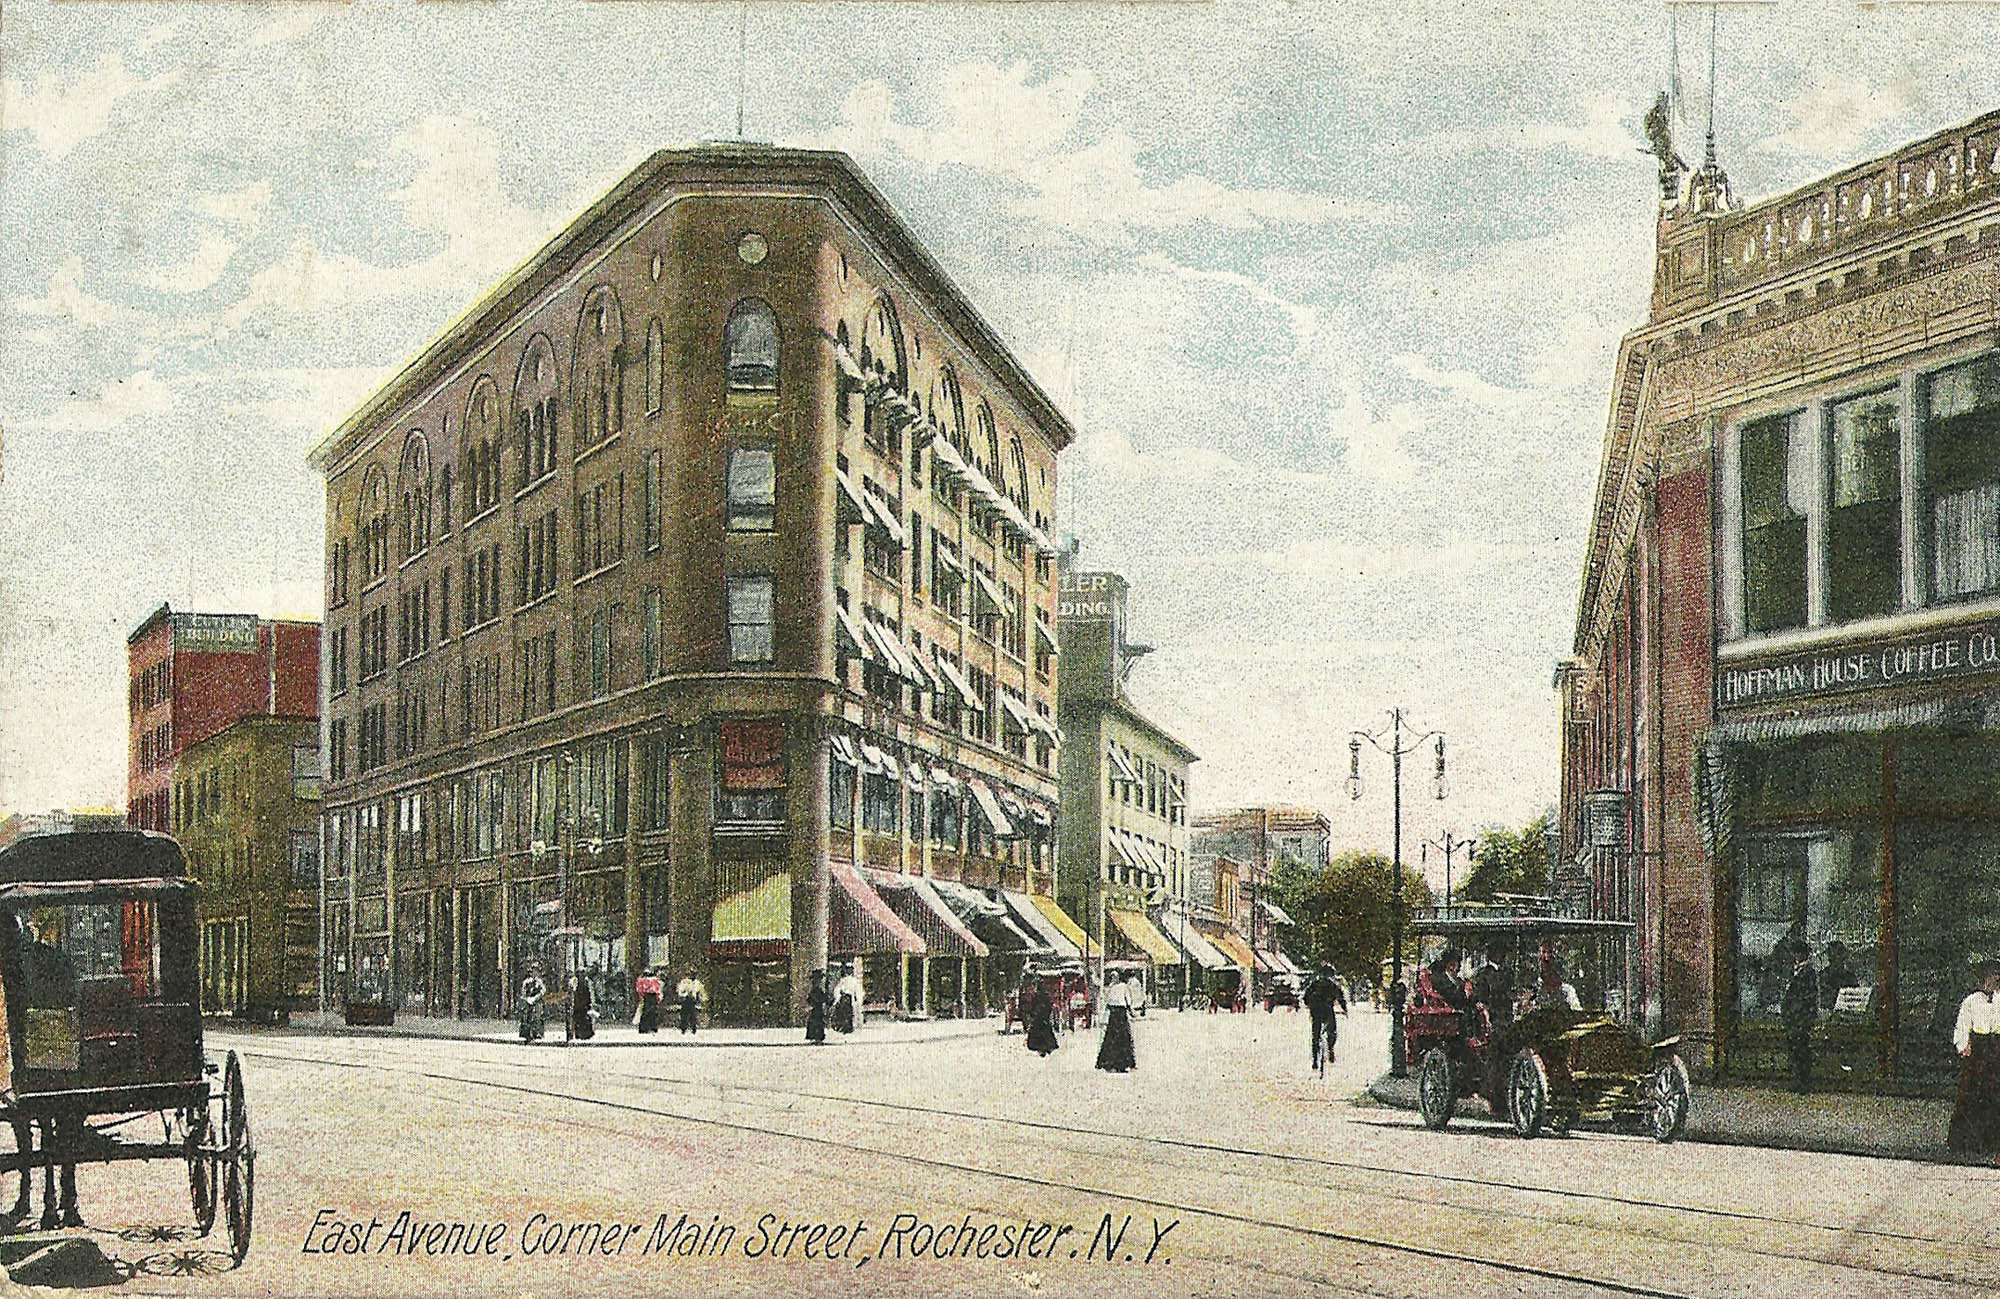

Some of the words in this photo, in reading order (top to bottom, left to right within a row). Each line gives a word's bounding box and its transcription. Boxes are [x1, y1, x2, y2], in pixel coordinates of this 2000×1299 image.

[1726, 664, 1804, 701] HOFFMAN
[1813, 655, 1870, 690] HOUSE
[1880, 639, 1960, 679] COFFEE
